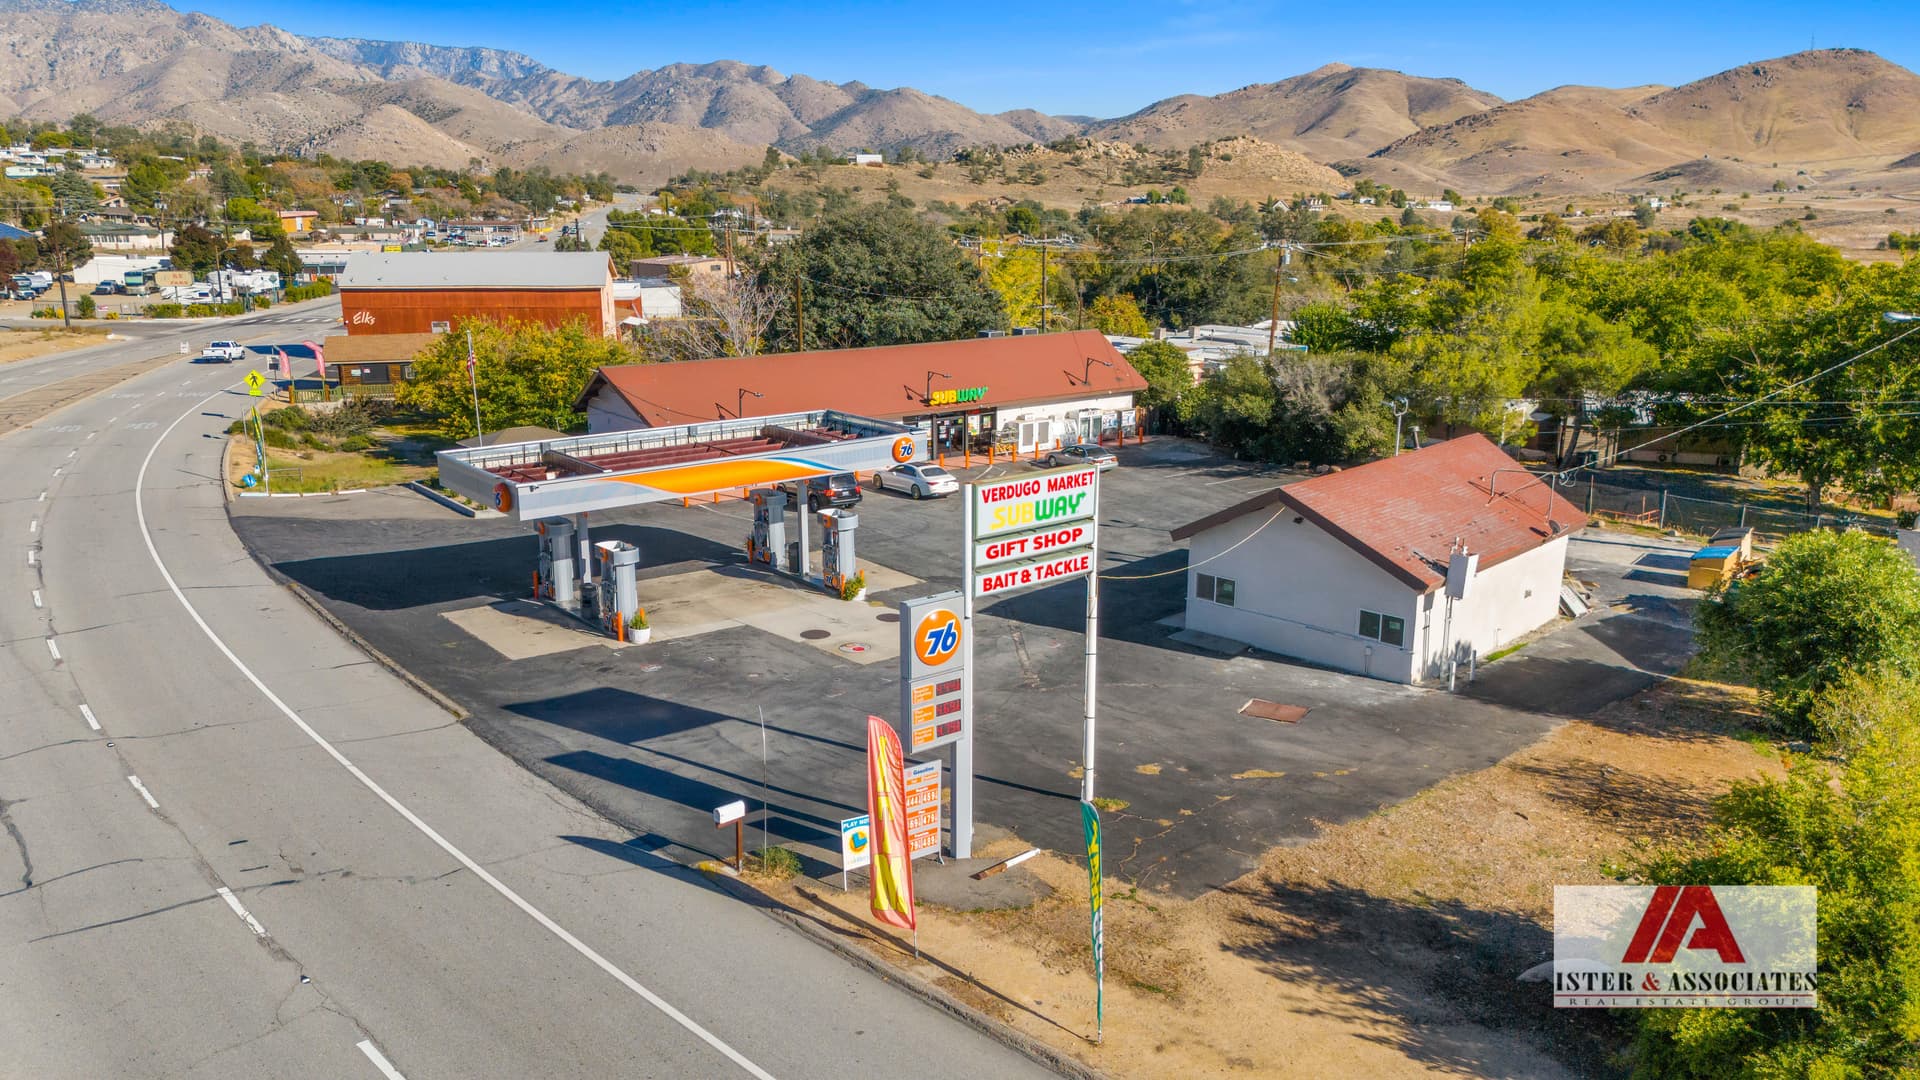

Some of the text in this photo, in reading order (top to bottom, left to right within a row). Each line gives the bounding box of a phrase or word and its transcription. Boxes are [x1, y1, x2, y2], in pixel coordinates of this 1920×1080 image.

[353, 311, 376, 325] Elks
[929, 386, 989, 406] SUBWAY
[900, 442, 913, 457] 76
[982, 471, 1095, 503] VERDUGO MARKET
[990, 491, 1087, 530] SUBWAY
[985, 528, 1083, 559] GIFT SHOP
[983, 556, 1089, 592] BAIT & TACKLE
[925, 619, 957, 657] 76
[843, 818, 870, 829] PLAY NO
